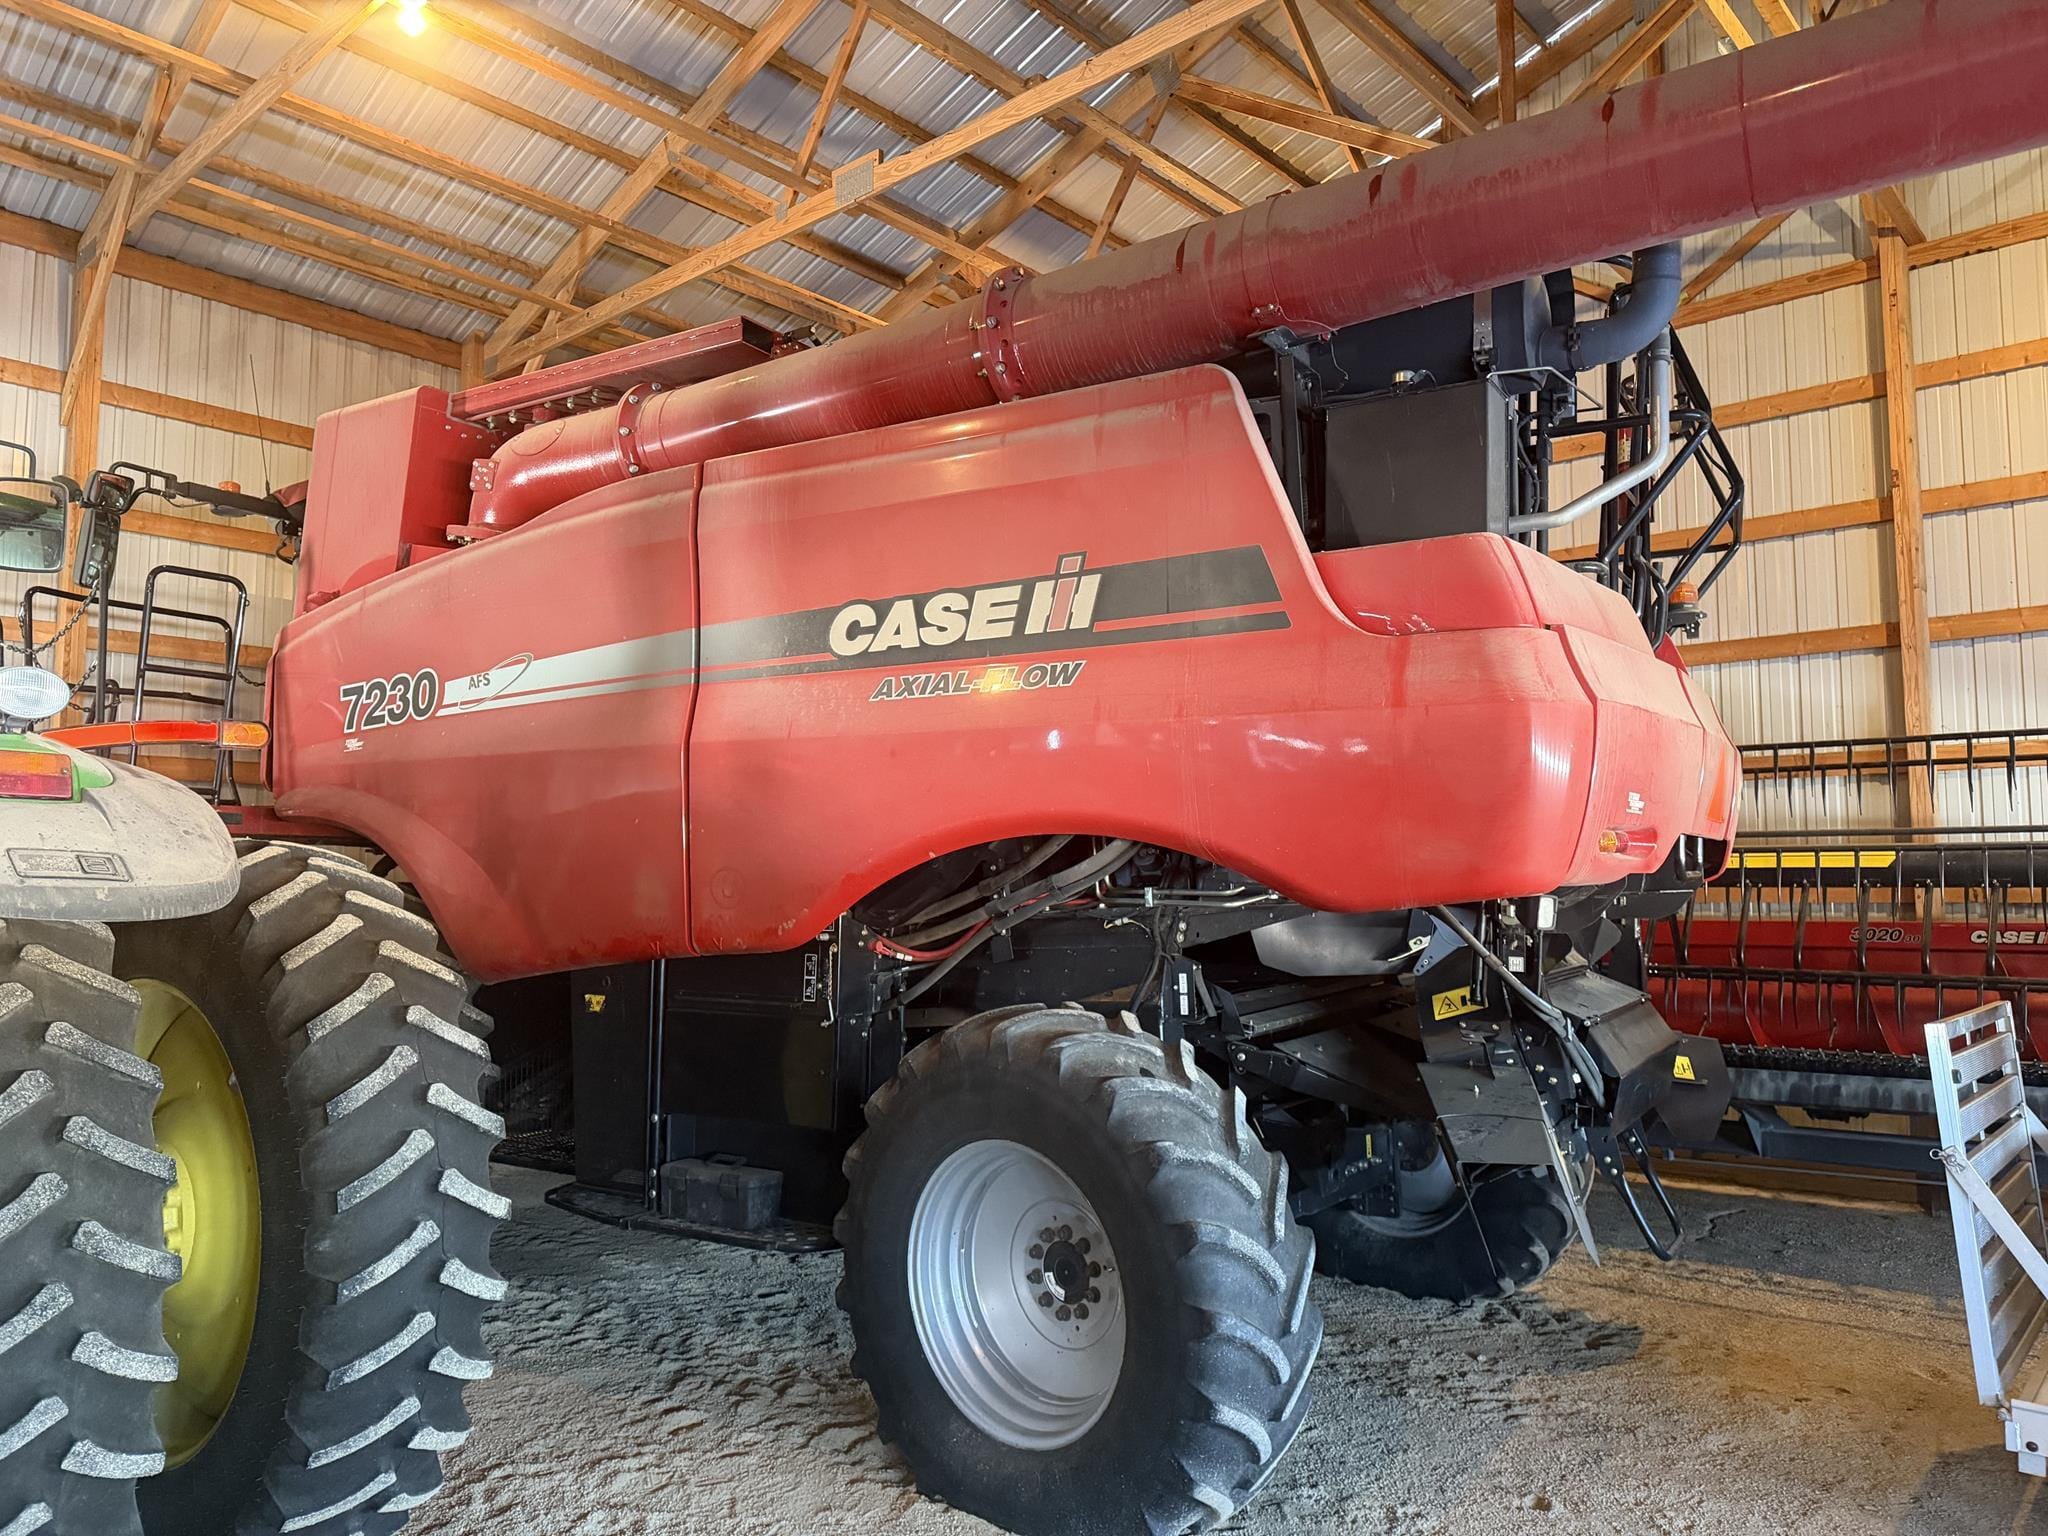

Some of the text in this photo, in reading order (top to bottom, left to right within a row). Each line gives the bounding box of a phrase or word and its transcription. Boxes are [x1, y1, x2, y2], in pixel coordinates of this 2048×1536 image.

[829, 585, 1022, 656] CASE
[340, 668, 439, 733] 7230
[468, 673, 491, 690] AFS
[869, 660, 1087, 701] AXIAL-FLOW
